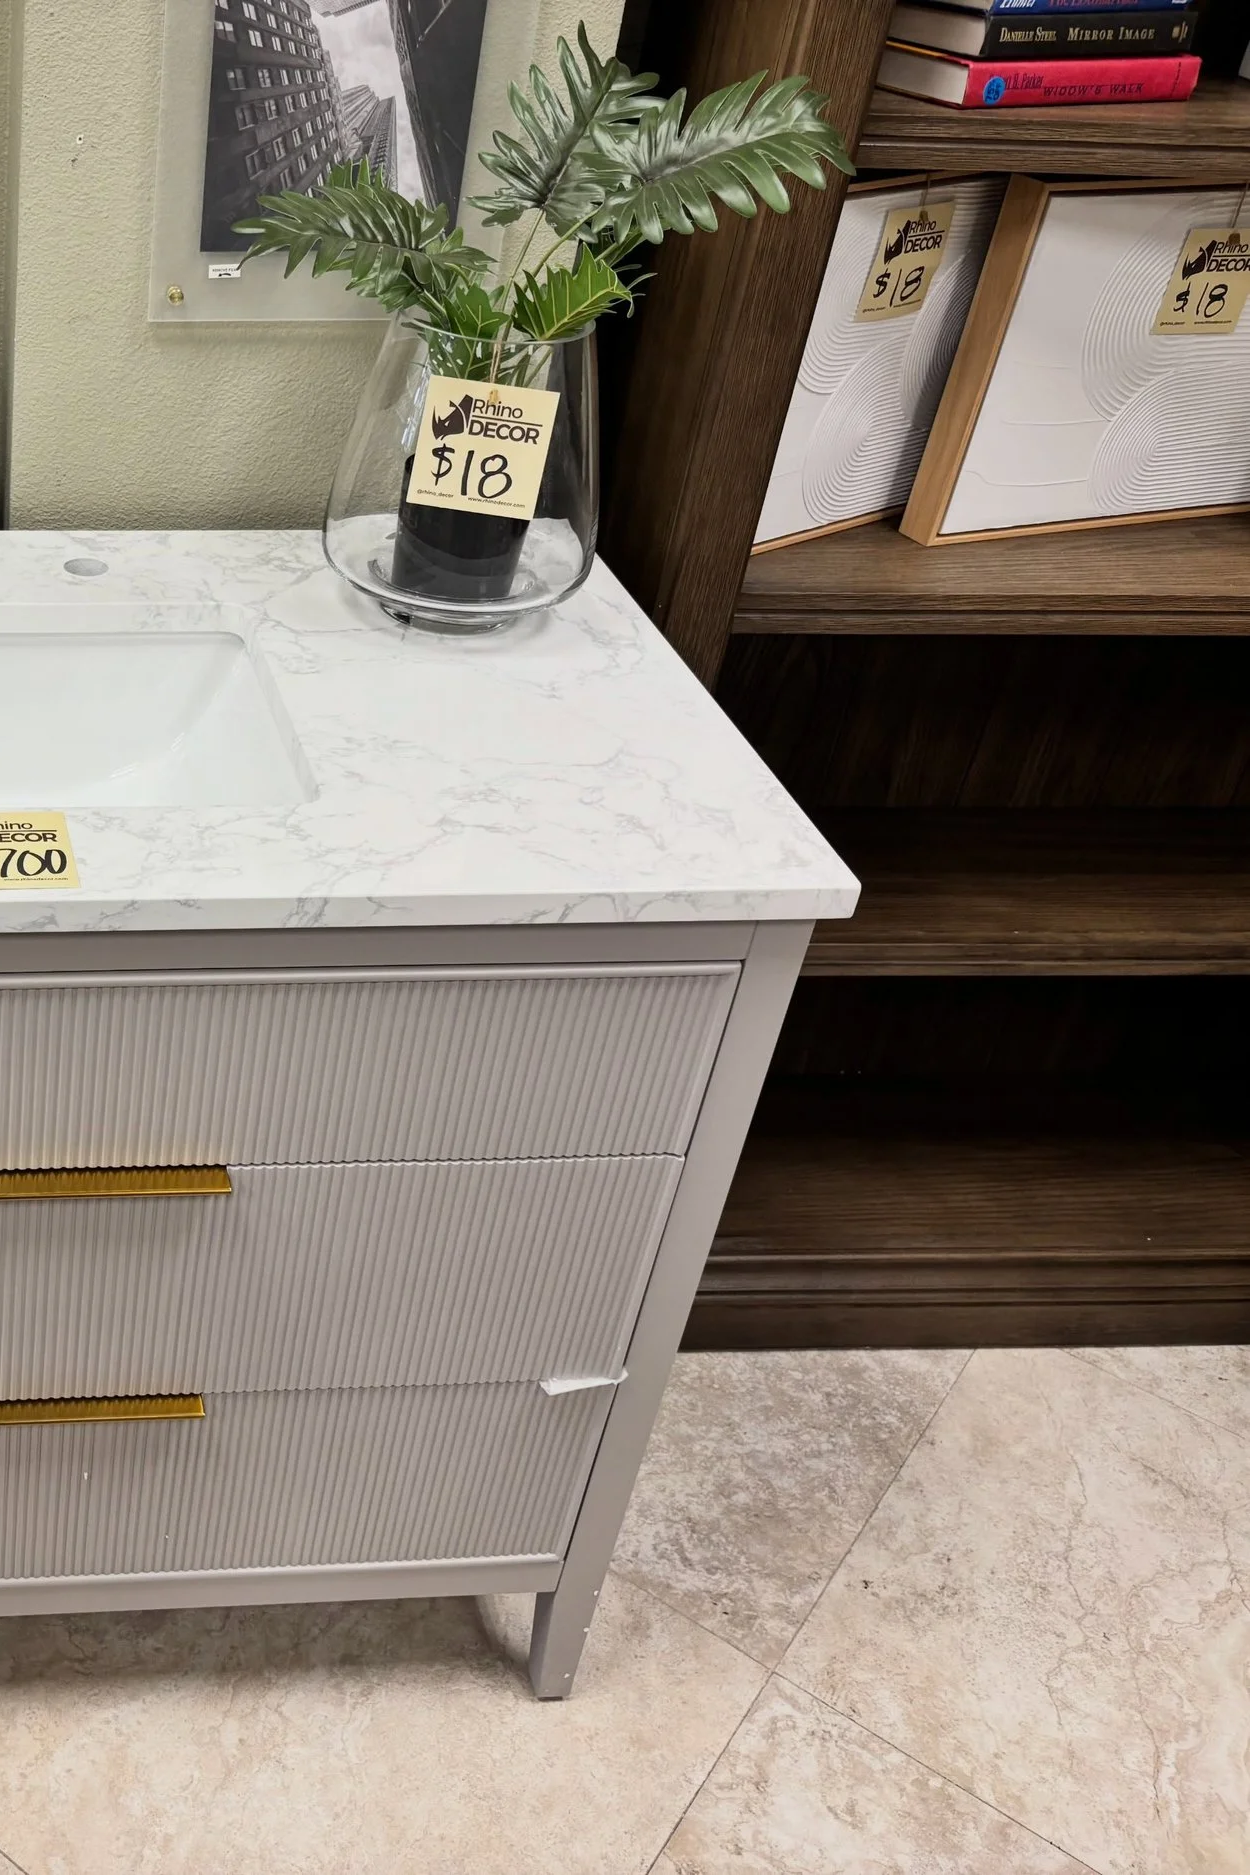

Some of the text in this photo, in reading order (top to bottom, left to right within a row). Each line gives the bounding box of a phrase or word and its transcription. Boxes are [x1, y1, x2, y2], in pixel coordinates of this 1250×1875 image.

[1034, 26, 1057, 42] STEEL
[1067, 27, 1114, 41] MIRROR
[1118, 26, 1155, 40] IMAGE
[1021, 72, 1044, 89] Parker
[1109, 82, 1144, 94] WALK
[909, 220, 937, 234] Rhino
[903, 234, 943, 254] DECOR
[1214, 241, 1249, 254] Rhino
[873, 266, 925, 307] $18
[1173, 281, 1228, 318] $18
[472, 398, 523, 419] Rhino
[468, 420, 540, 445] DECOR
[431, 443, 513, 499] $18
